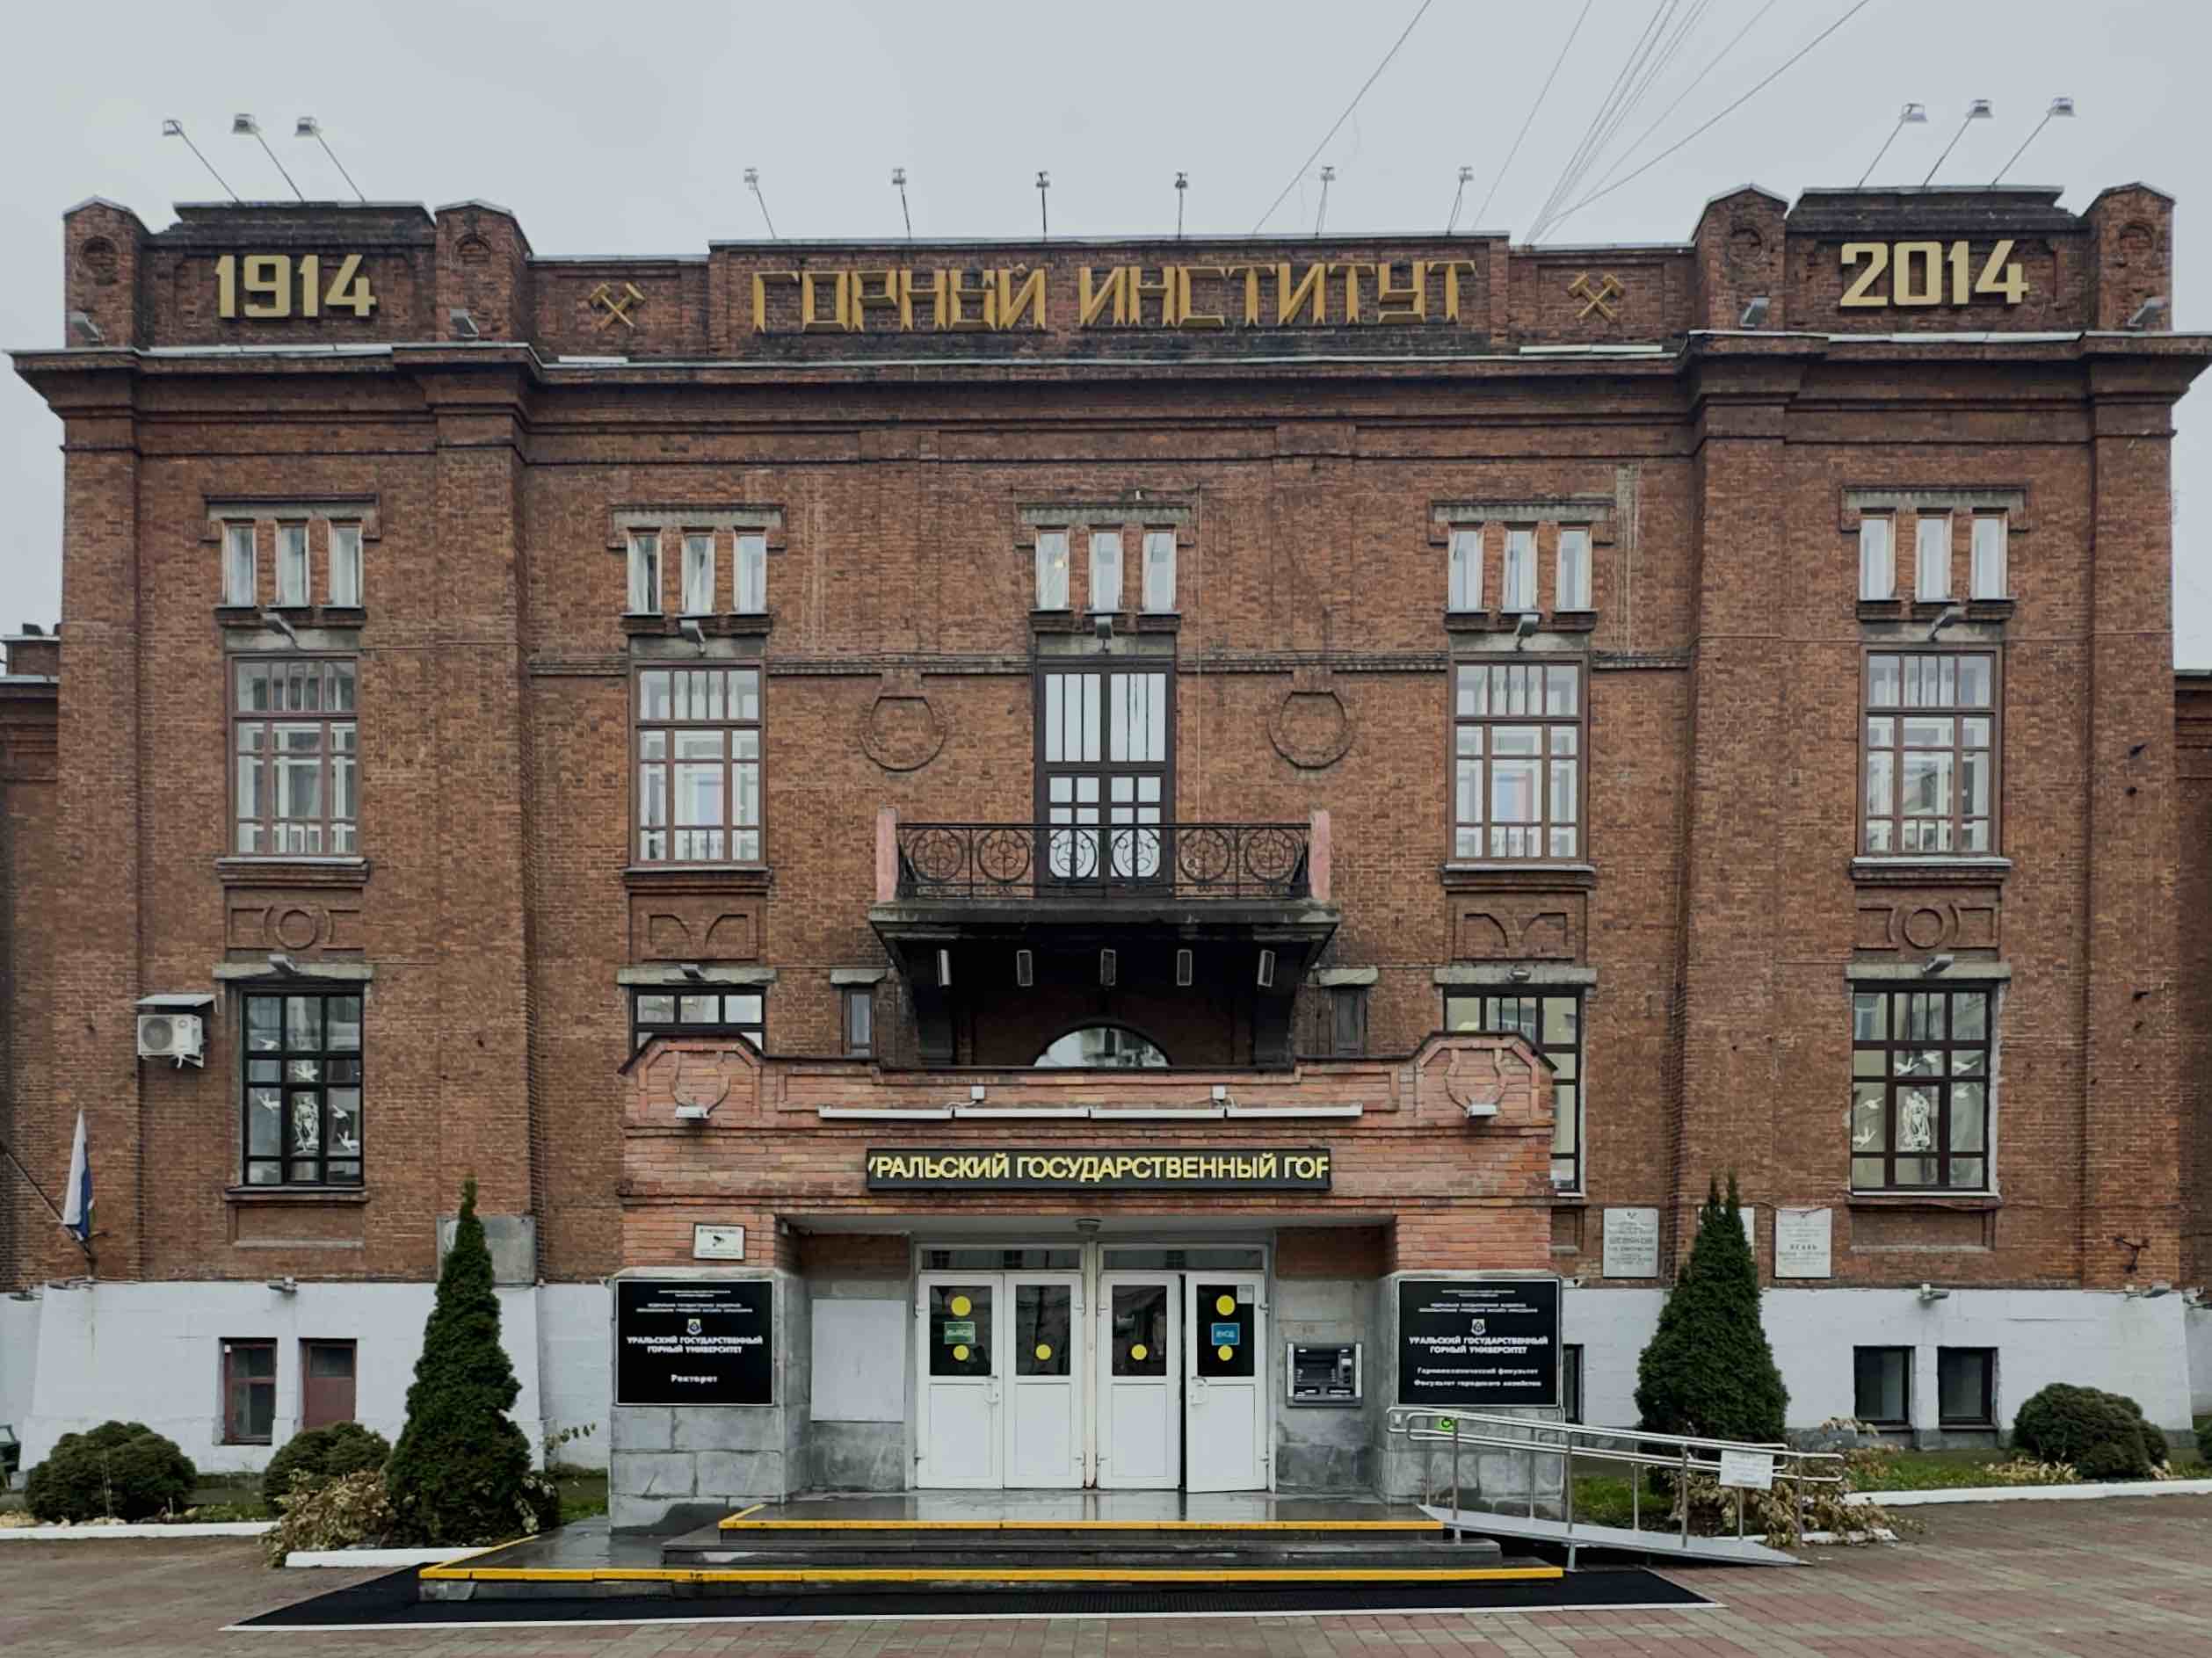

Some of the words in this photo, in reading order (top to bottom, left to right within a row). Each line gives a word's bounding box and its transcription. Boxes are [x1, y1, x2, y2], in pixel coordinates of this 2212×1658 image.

[1840, 240, 2029, 307] 2014
[214, 253, 377, 319] 1914
[752, 263, 1046, 332] ГОРНЫЙ
[1078, 260, 1476, 329] ИНСТИТУТ
[1017, 1153, 1277, 1183] ГОСУДАРСТВЕННЫЙ
[627, 1336, 678, 1344] УРАЛЬСКИЙ
[679, 1336, 763, 1345] ГОСУДАРСТВЕННЫЙ
[647, 1344, 684, 1354] ГОРНЫЙ
[685, 1345, 743, 1354] УНИВЕРСИТЕТ
[1409, 1336, 1461, 1345] УРАЛЬСКИЙ
[1463, 1336, 1548, 1345] ГОСУДАРСТВЕННЫЙ
[1430, 1345, 1467, 1354] ГОРНЫЙ
